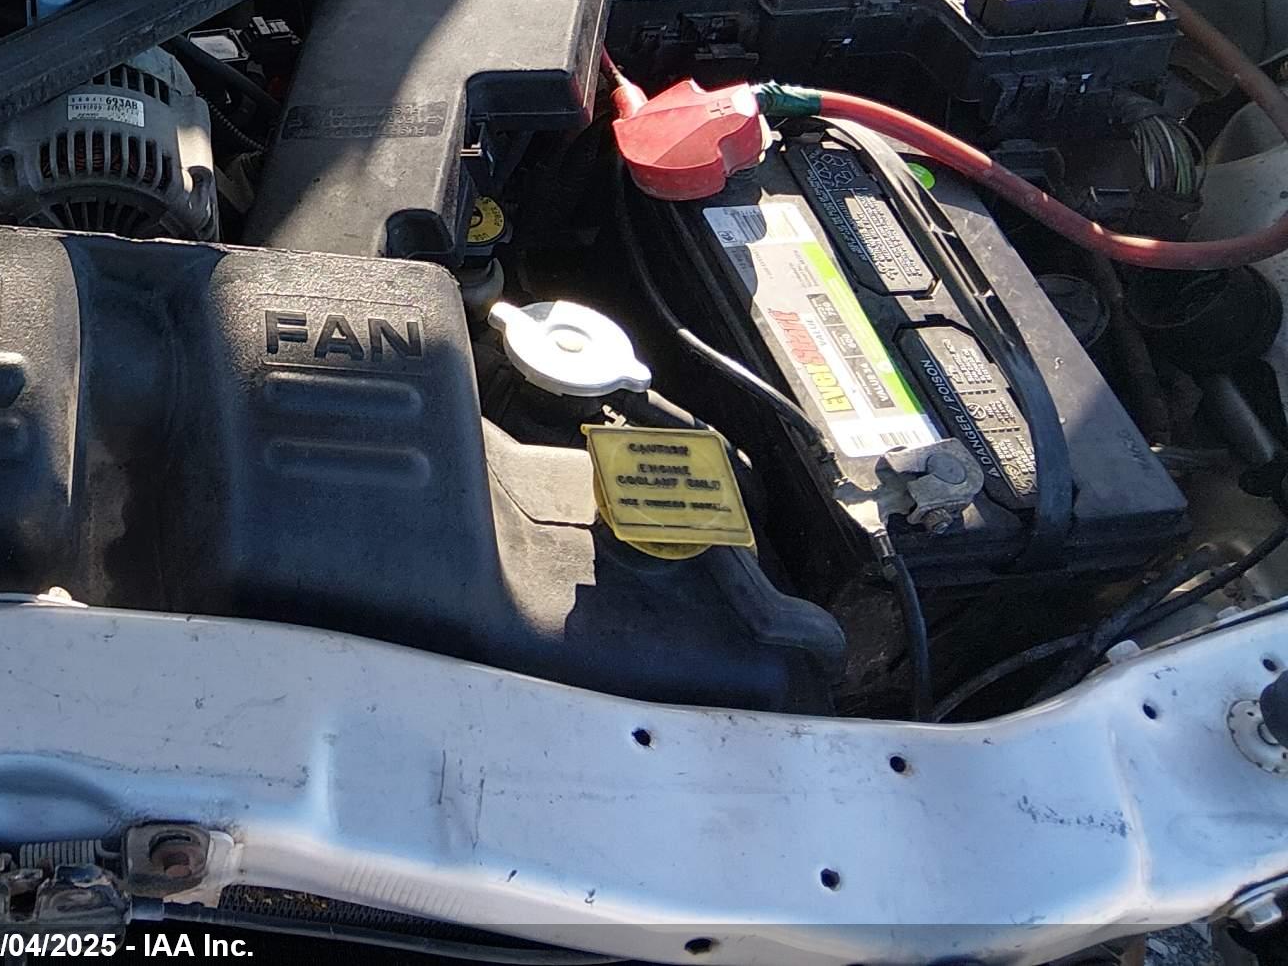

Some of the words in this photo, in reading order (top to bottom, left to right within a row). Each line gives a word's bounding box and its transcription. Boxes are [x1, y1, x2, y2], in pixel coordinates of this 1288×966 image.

[265, 309, 423, 361] FAN
[772, 308, 855, 413] EverStart
[921, 359, 955, 403] POISON
[955, 415, 993, 465] DANGER
